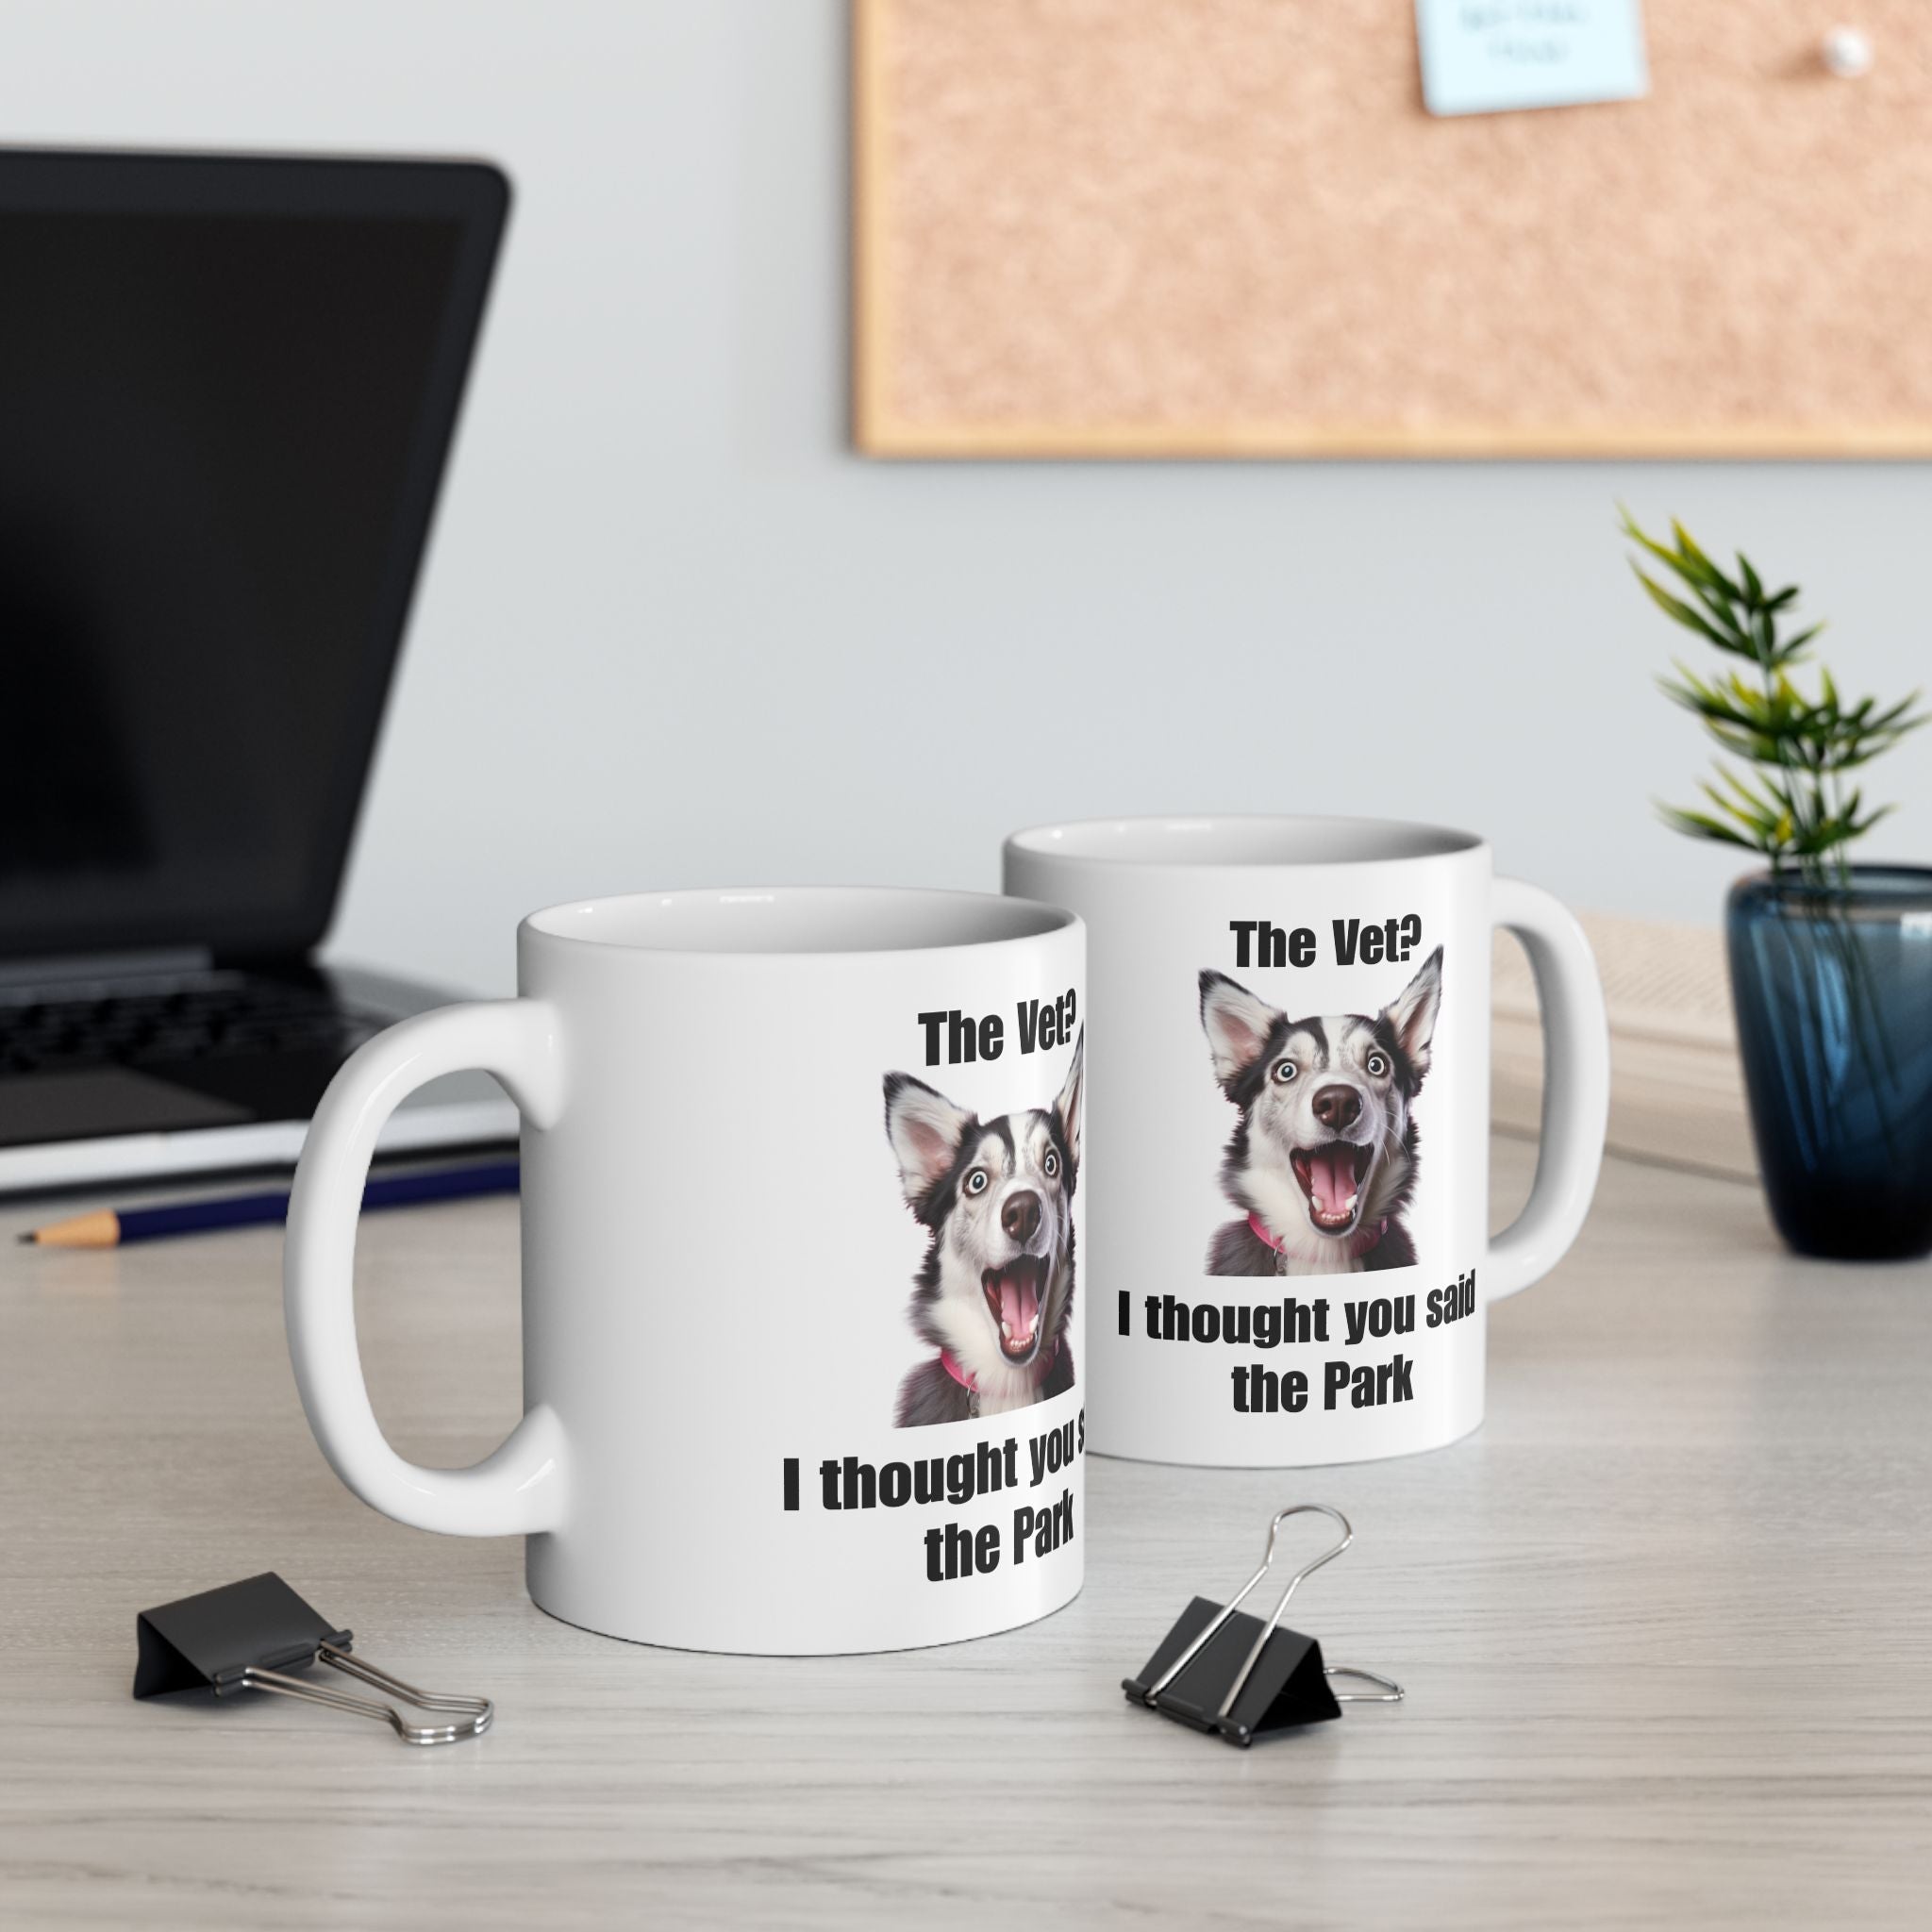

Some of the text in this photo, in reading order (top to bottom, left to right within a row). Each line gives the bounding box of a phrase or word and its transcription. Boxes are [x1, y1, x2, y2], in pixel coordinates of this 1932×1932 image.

[1230, 913, 1423, 968] The Vet?
[918, 988, 1076, 1066] The Vet?
[1119, 1269, 1476, 1349] I thought you said
[1231, 1354, 1414, 1413] the Park
[783, 1457, 800, 1511] I
[819, 1438, 1018, 1510] thought
[1029, 1419, 1074, 1488] you
[924, 1488, 1074, 1582] the Park
